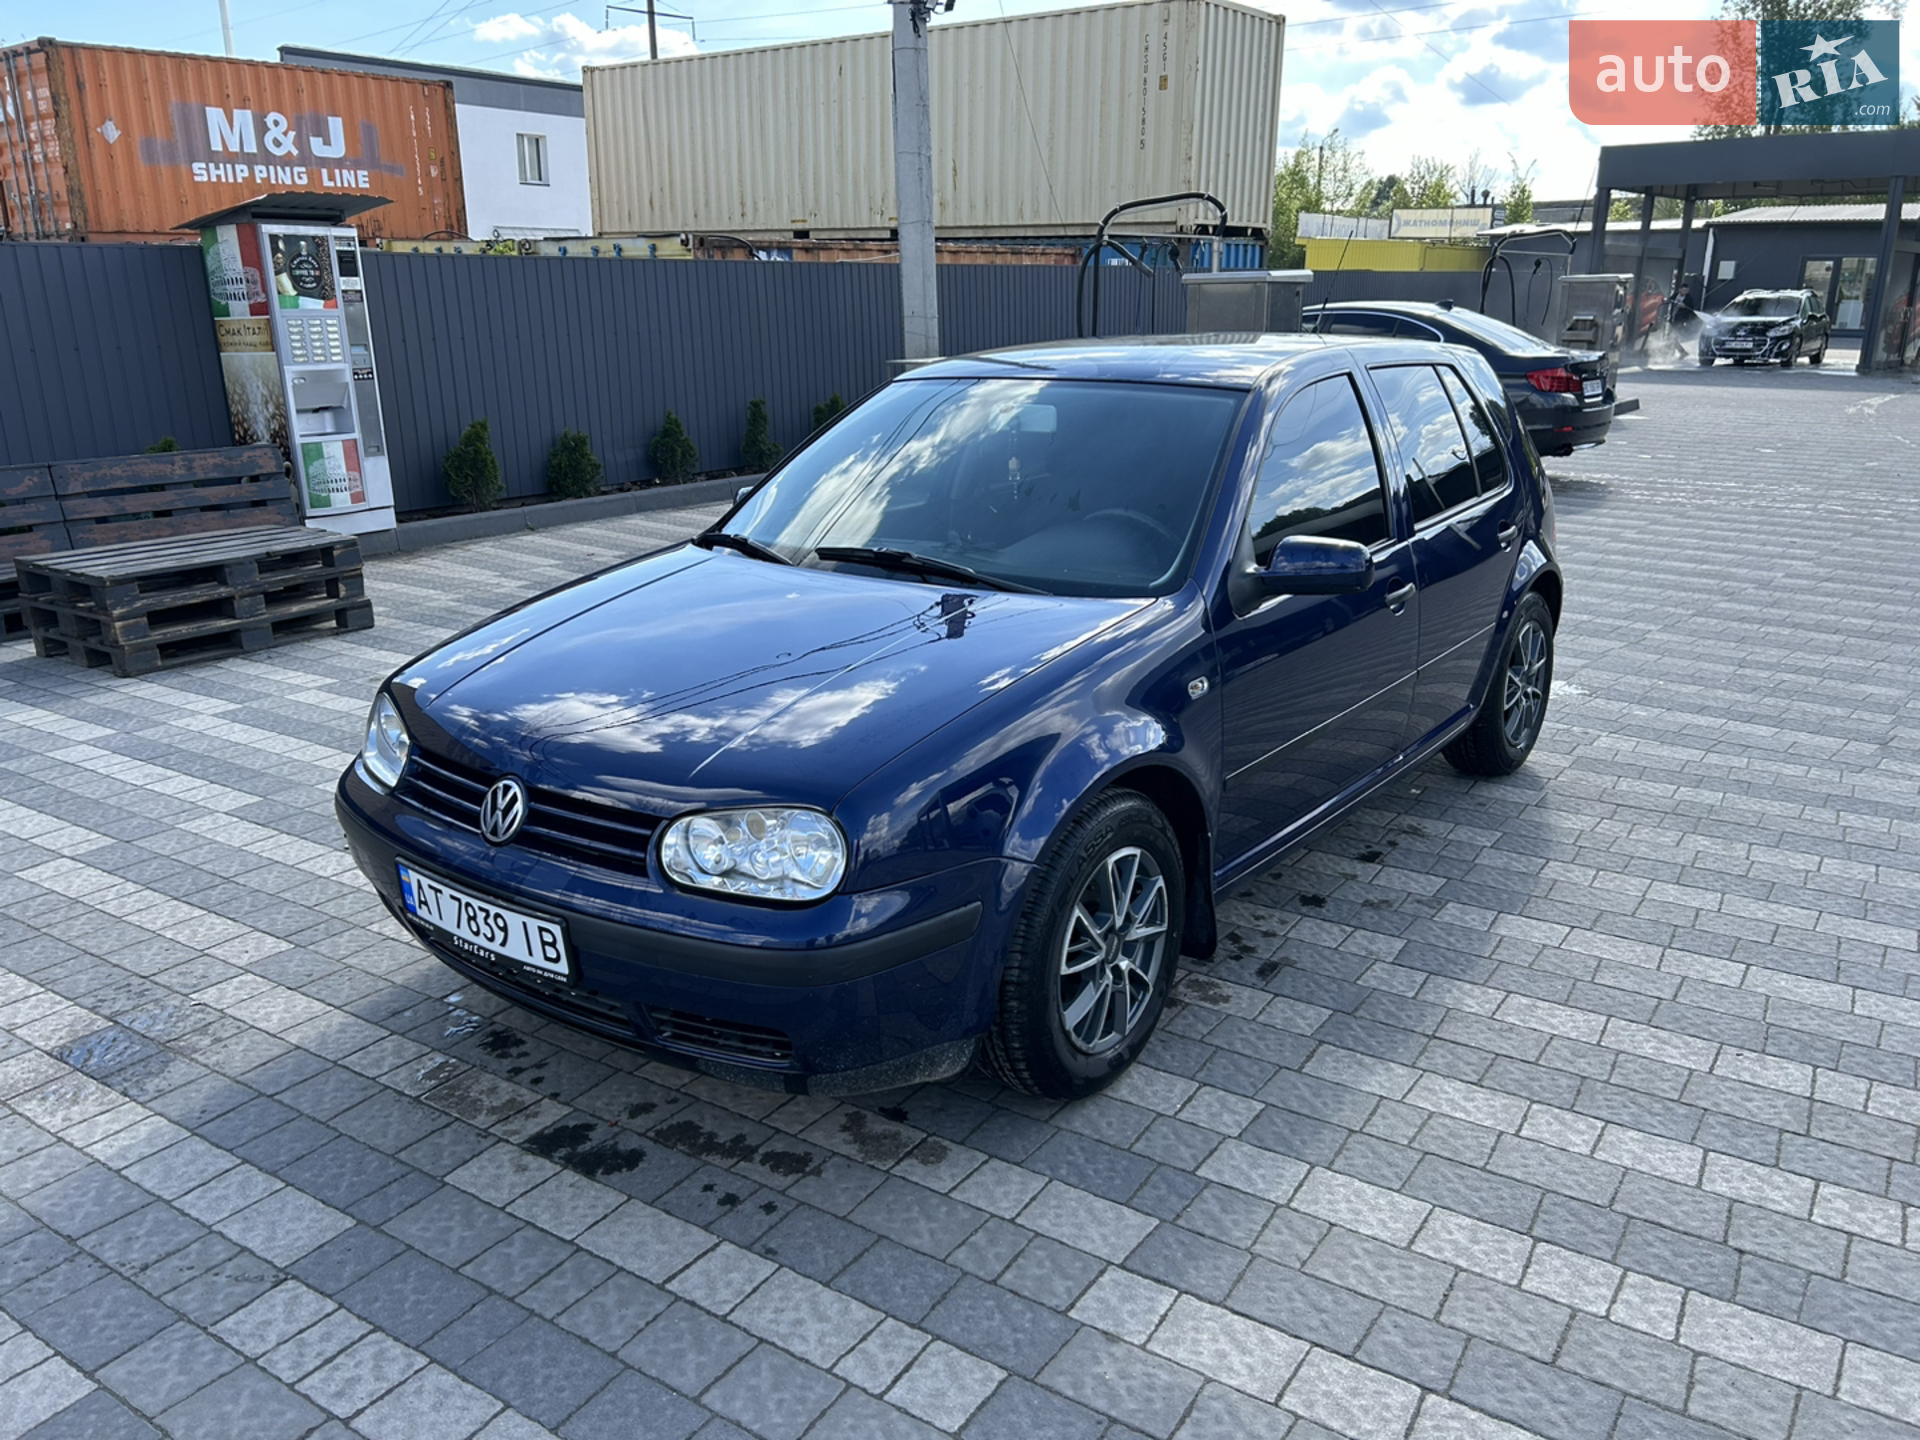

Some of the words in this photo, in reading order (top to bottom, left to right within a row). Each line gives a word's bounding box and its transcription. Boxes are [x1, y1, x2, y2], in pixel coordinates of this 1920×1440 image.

[191, 162, 308, 186] SHIPPING
[320, 167, 370, 189] LINE
[417, 878, 443, 921] AT
[449, 894, 509, 948] 7839
[522, 921, 562, 965] IB
[453, 936, 496, 961] StarCars
